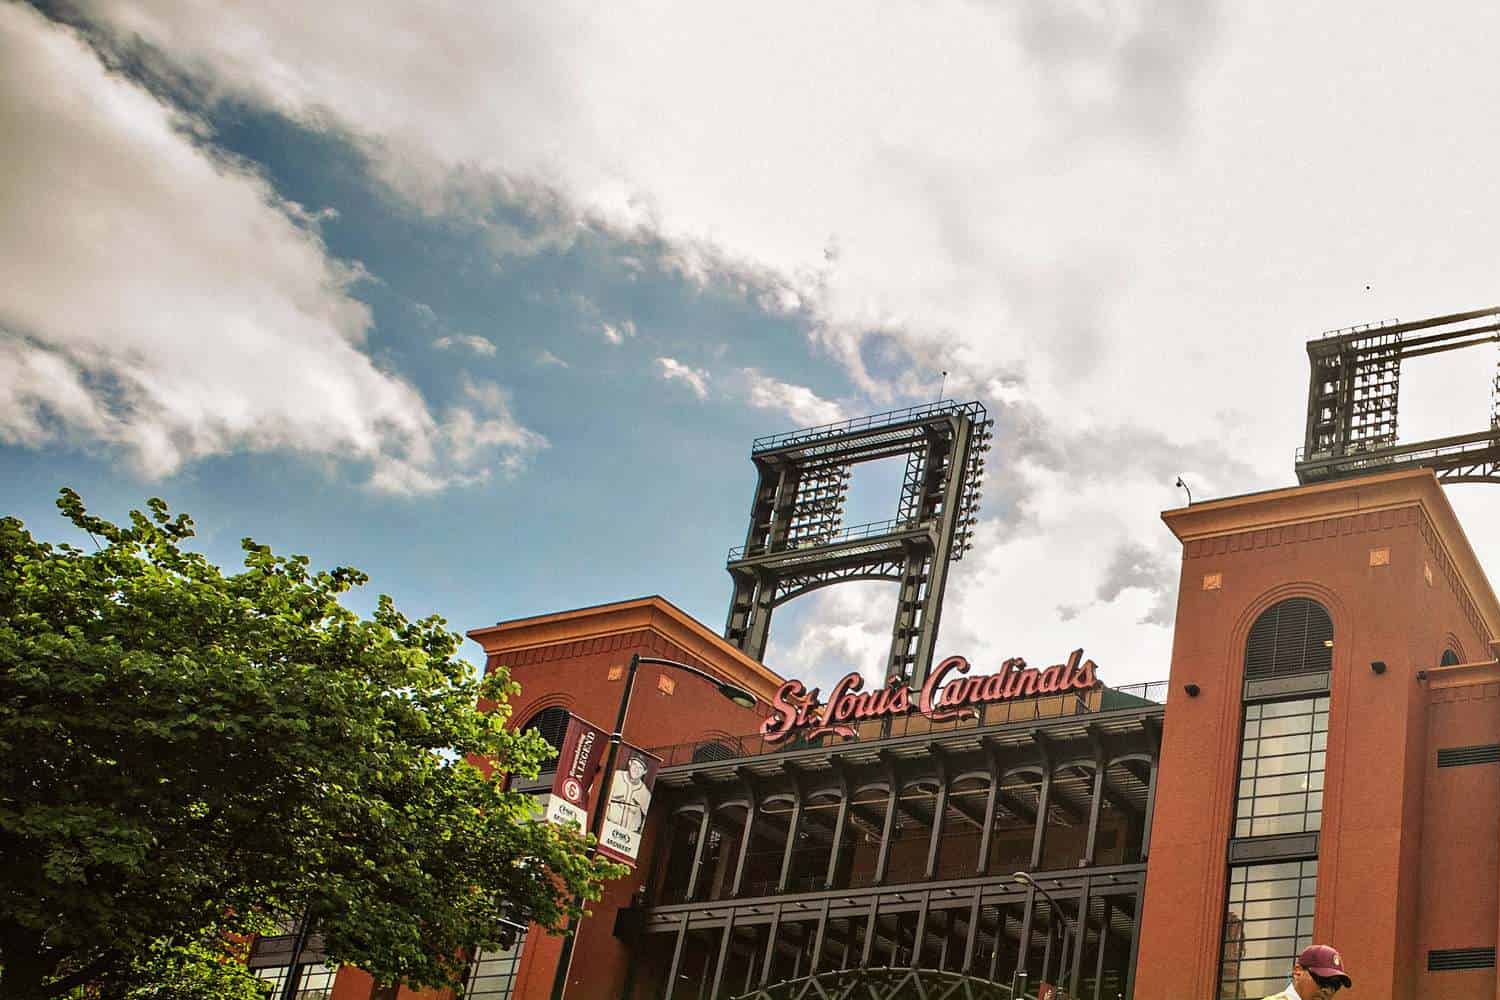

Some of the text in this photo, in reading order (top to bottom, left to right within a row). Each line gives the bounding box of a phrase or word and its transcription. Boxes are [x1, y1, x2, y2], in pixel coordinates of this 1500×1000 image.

[806, 671, 911, 741] Louis
[919, 648, 1098, 721] Cardinals
[577, 731, 596, 772] LEGEND
[568, 783, 577, 798] 6
